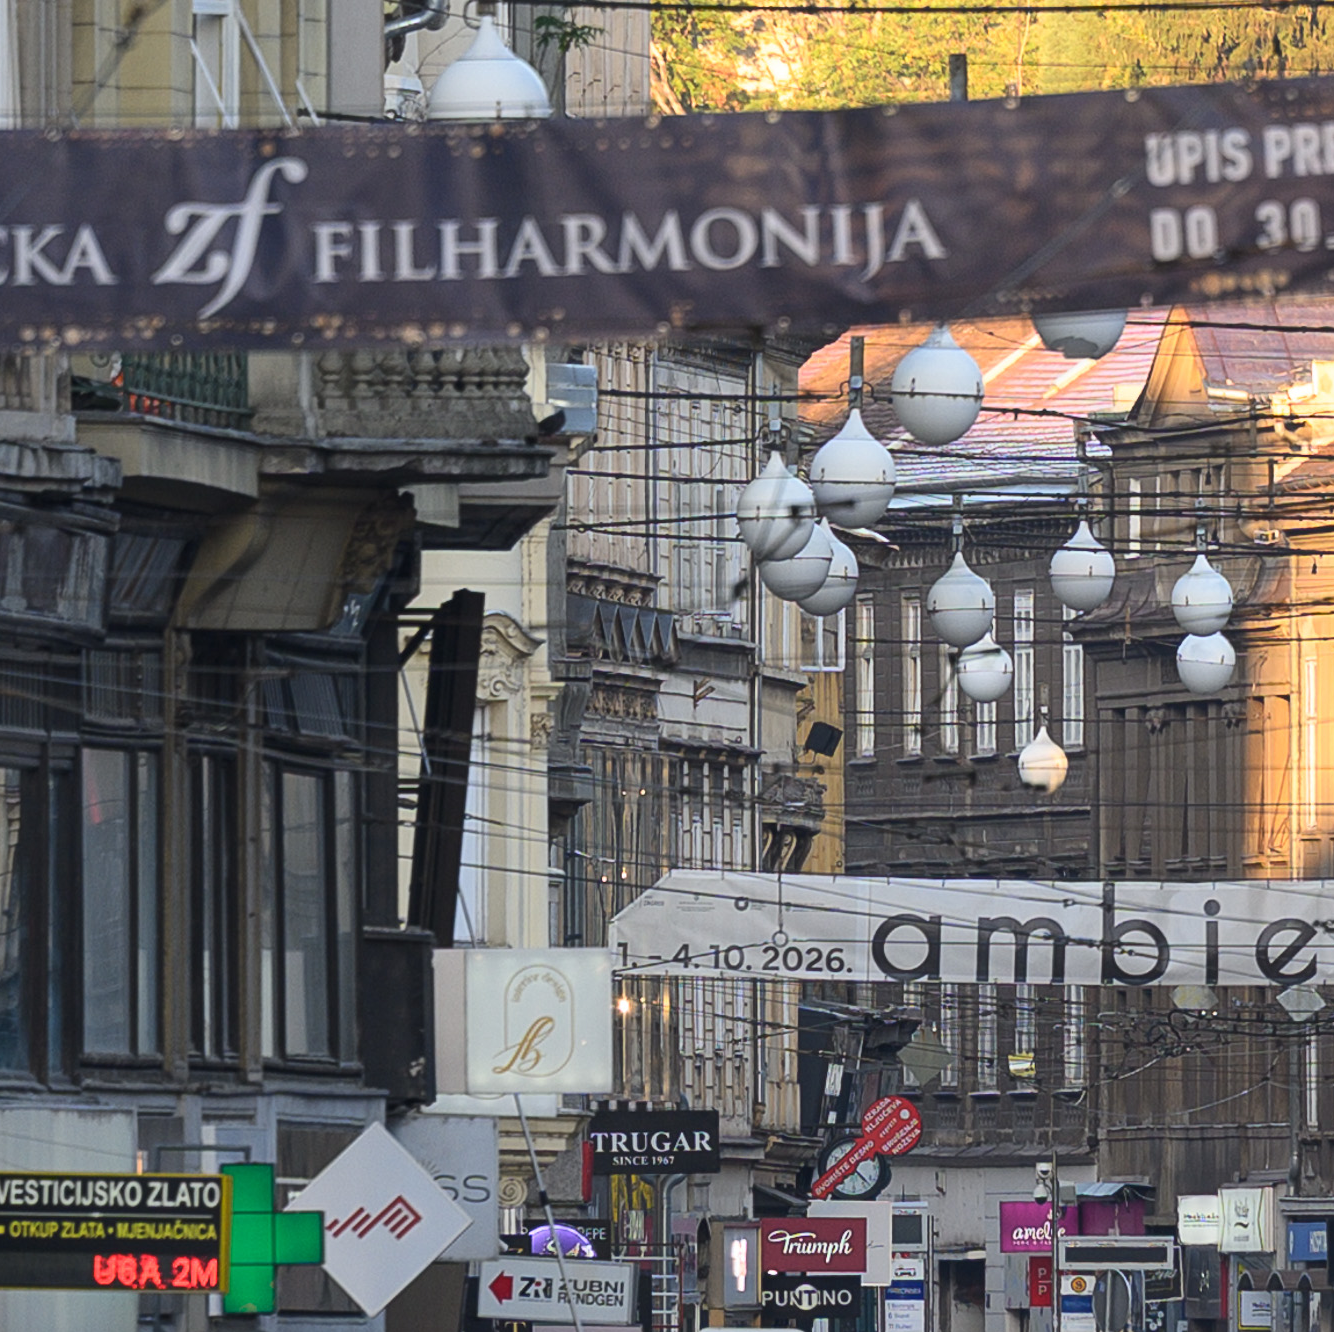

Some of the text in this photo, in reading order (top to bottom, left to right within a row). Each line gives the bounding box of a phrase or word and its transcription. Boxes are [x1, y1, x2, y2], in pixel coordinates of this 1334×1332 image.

[1145, 130, 1253, 188] UPIS
[313, 200, 947, 284] FILHARMONIJA
[1149, 206, 1219, 263] DO
[762, 946, 854, 974] 2026.
[591, 1131, 712, 1154] TRUGAR
[613, 1155, 675, 1166] SINCE 1967
[147, 1182, 220, 1209] ZLATO
[9, 1220, 218, 1241] OTKUP ZLATA MJENJAČNICA
[1013, 1221, 1066, 1240] amele
[768, 1229, 852, 1263] Triumph
[762, 1284, 852, 1310] PUNTINO
